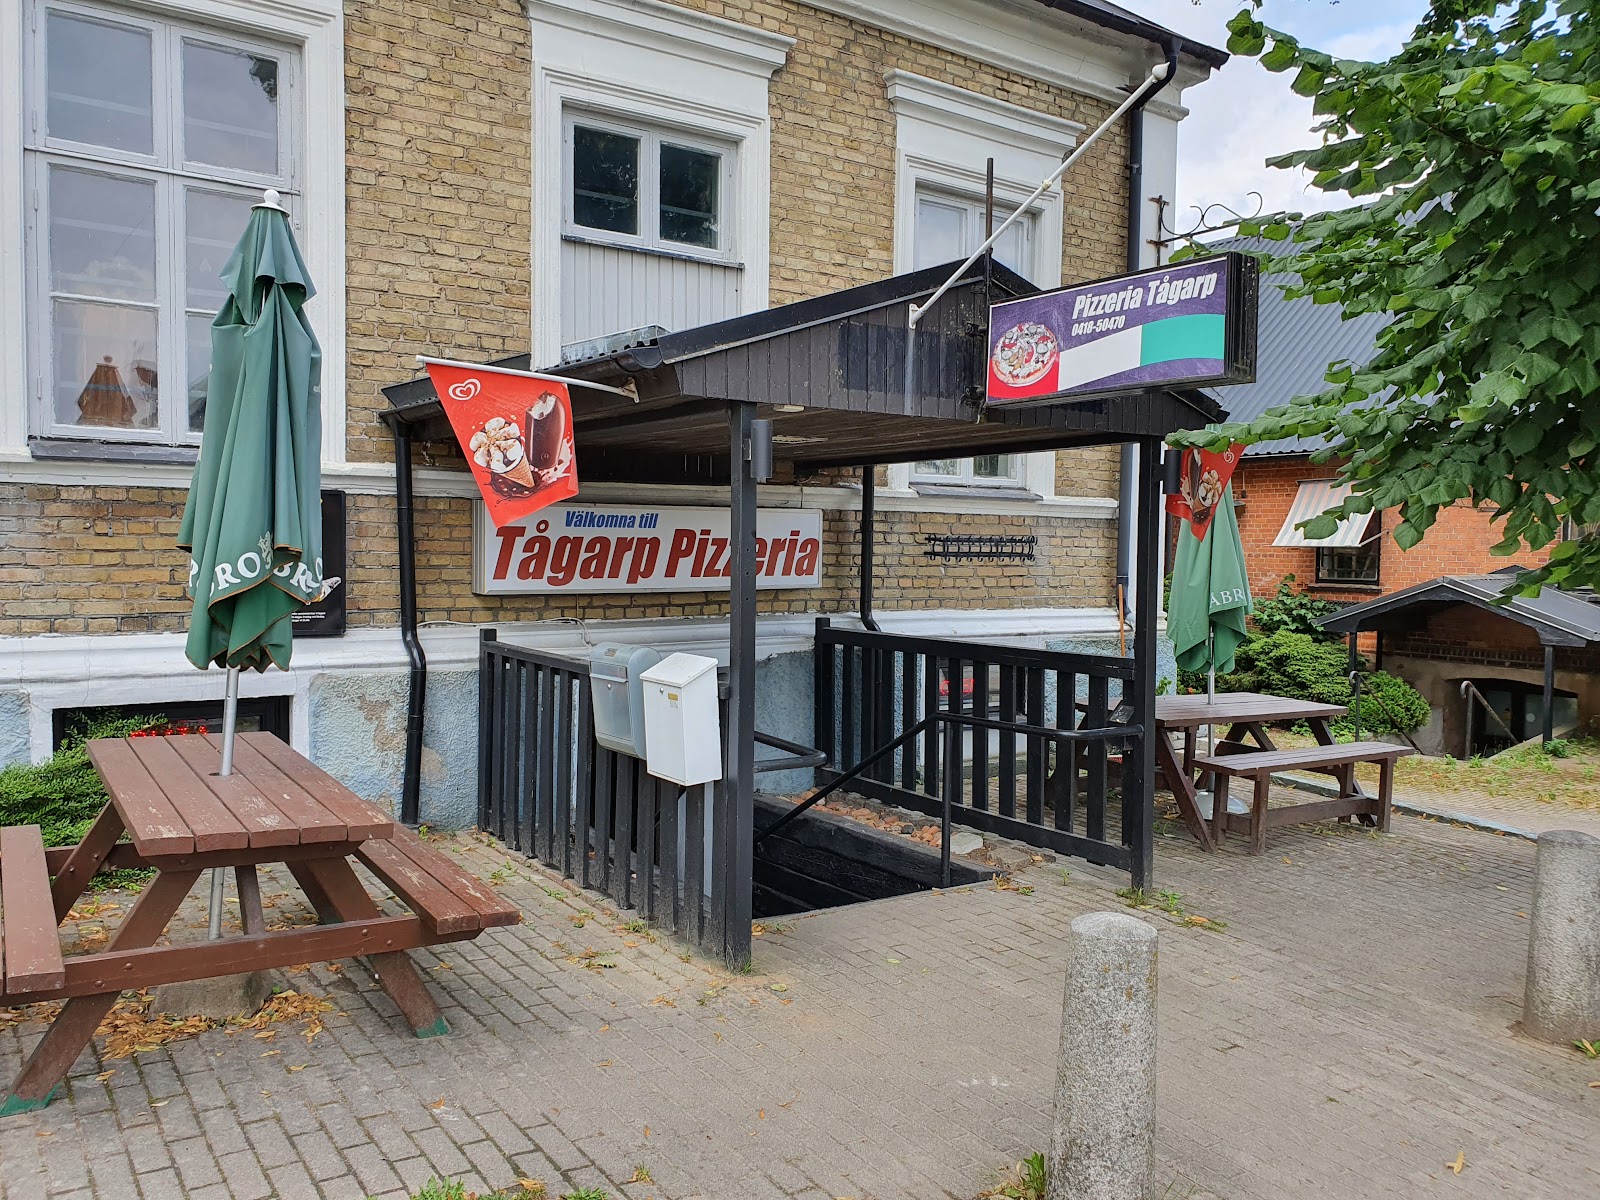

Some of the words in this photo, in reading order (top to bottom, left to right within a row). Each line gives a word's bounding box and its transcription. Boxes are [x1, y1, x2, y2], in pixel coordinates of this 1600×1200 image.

[1072, 285, 1144, 320] Pizzeria
[1146, 272, 1218, 306] Tågarp
[1071, 315, 1126, 337] 0418-50470
[564, 510, 637, 529] Välkomna
[638, 512, 659, 529] till
[492, 519, 661, 587] Tågarp
